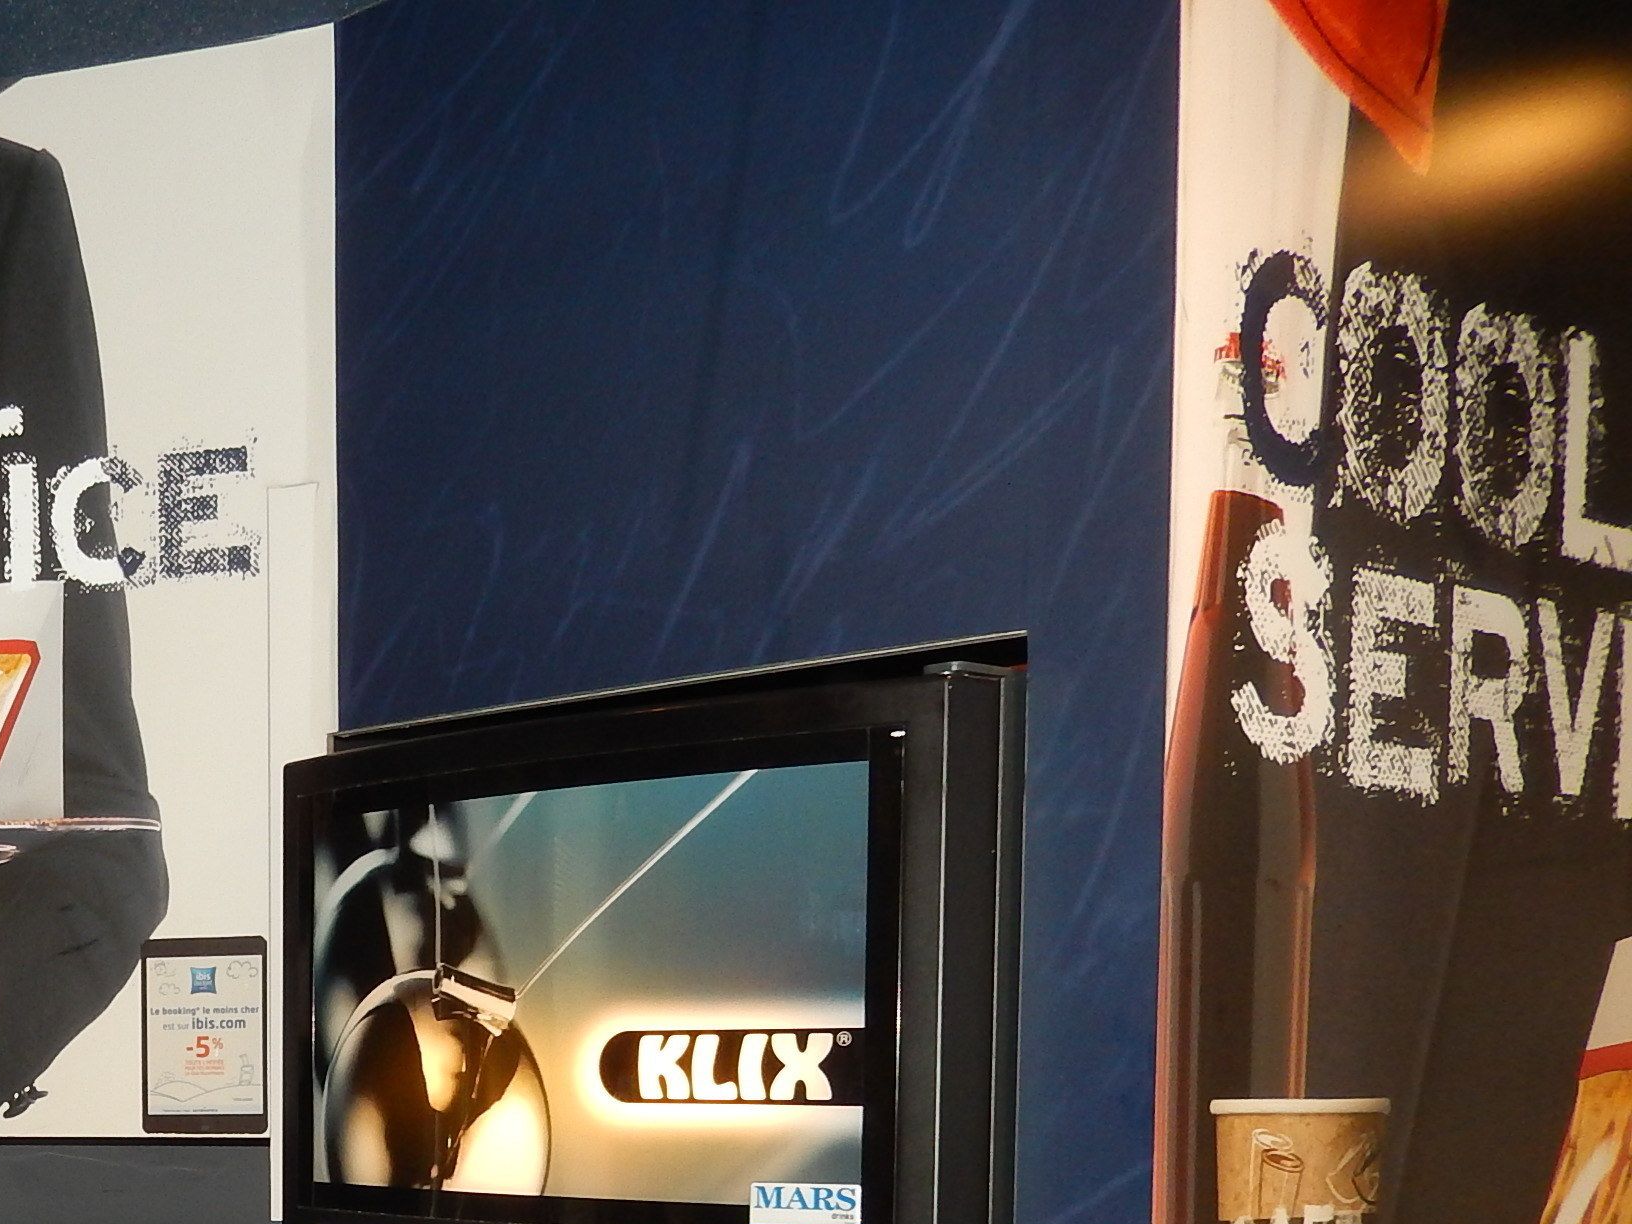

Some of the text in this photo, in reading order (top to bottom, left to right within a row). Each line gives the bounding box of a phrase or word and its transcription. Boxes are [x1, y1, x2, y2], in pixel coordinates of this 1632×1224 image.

[1234, 245, 1632, 572] COOL
[150, 1007, 160, 1015] Le
[192, 1017, 247, 1030] ibis.com
[638, 1032, 834, 1101] KLIX
[754, 1186, 856, 1211] MARS
